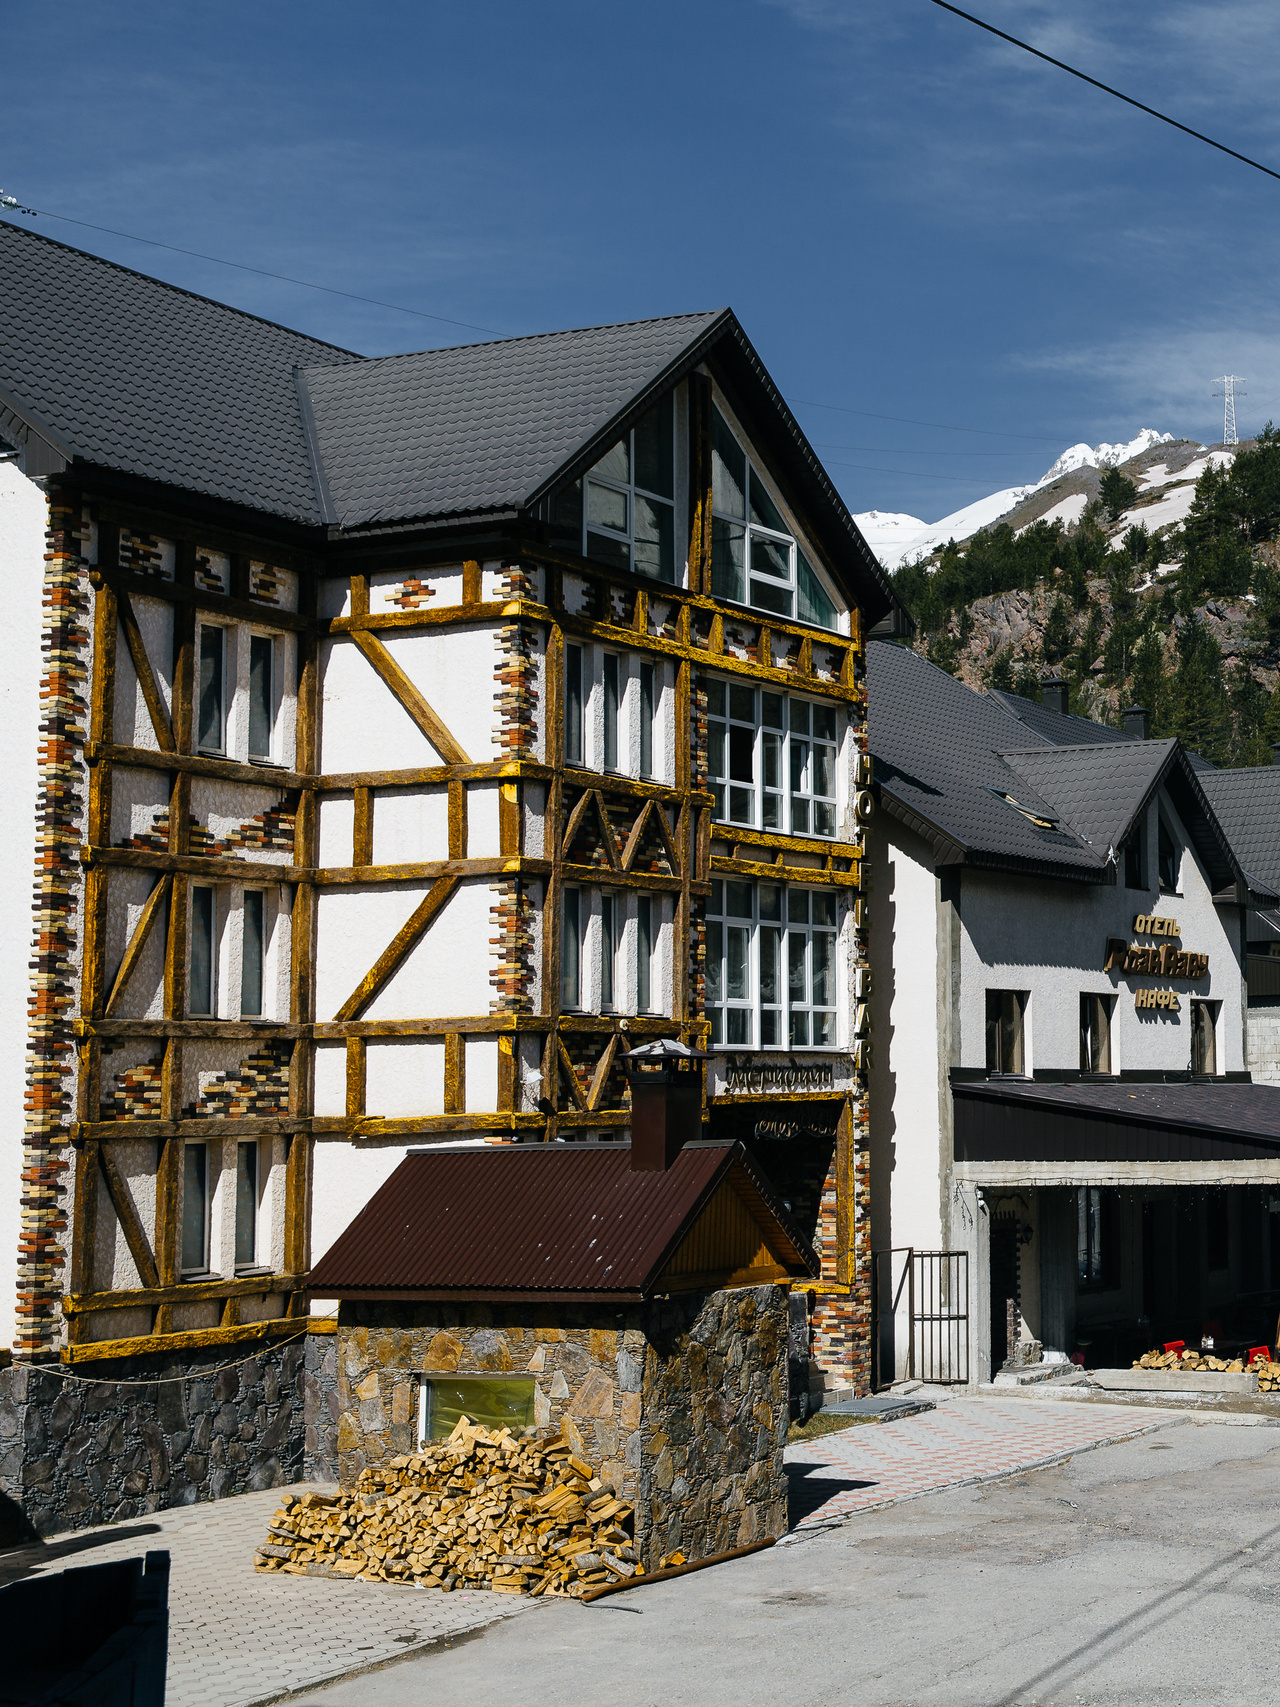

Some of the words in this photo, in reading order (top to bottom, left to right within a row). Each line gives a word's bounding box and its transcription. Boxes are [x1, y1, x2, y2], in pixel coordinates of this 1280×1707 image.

[854, 753, 875, 929] HOTEL
[1134, 914, 1181, 937] ОТЕЛЬ
[854, 968, 875, 1069] BAR
[1135, 989, 1181, 1010] КАФЕ
